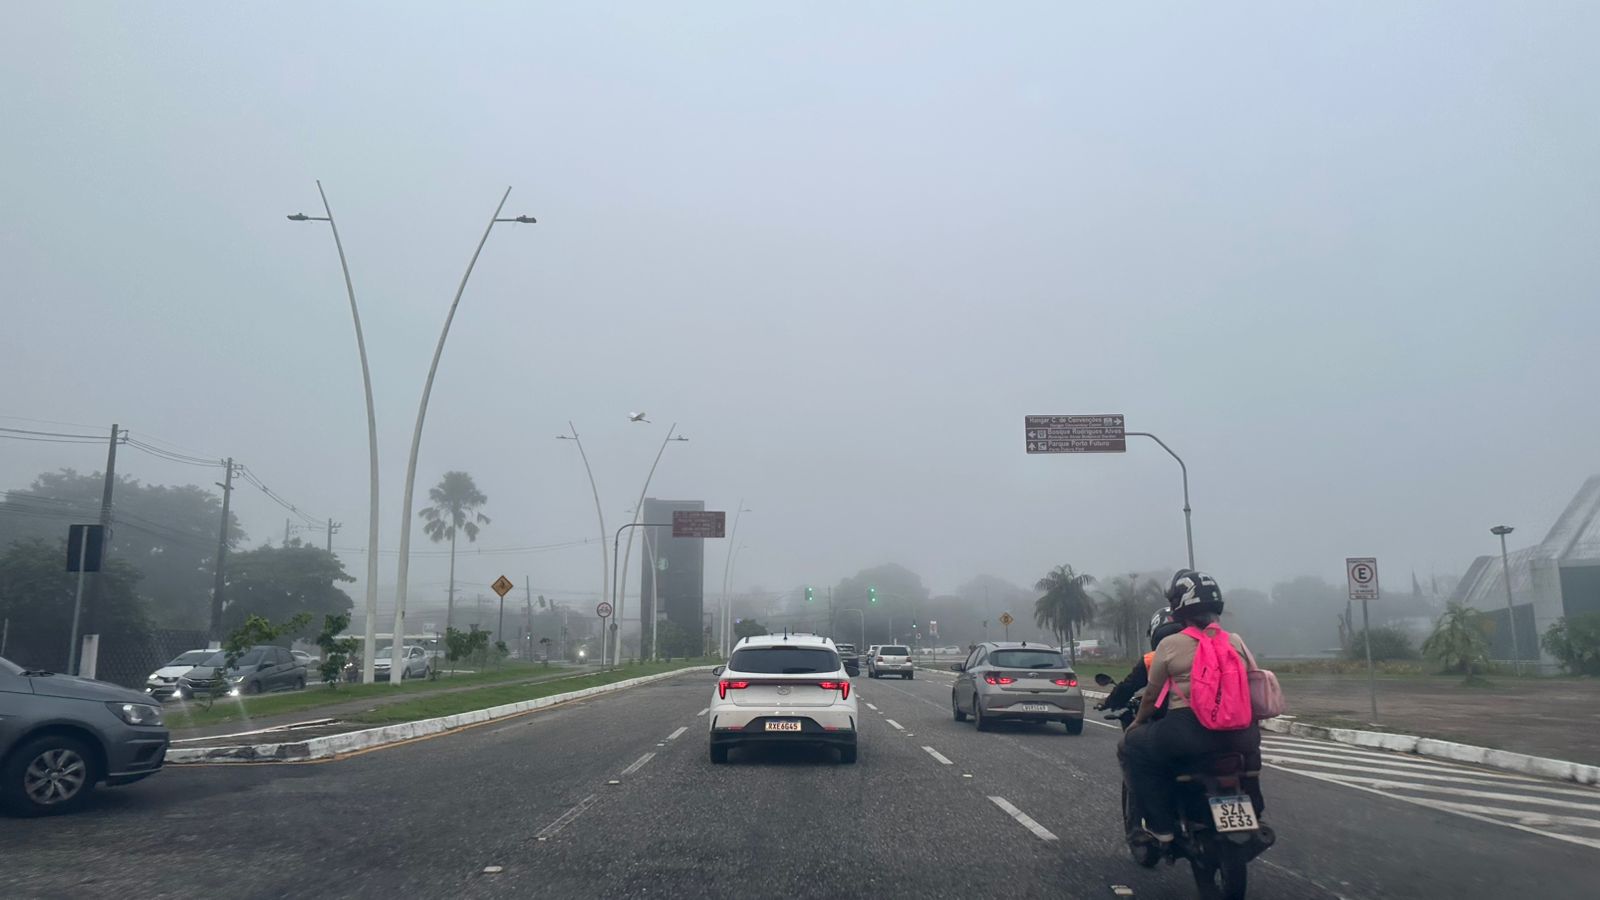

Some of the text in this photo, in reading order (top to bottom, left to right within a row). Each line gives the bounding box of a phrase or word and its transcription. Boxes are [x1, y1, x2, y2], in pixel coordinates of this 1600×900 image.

[1029, 417, 1049, 425] Hangar
[1048, 428, 1070, 436] Bosque
[1048, 440, 1069, 448] Parque
[1358, 567, 1367, 580] E
[1220, 803, 1246, 816] SZA
[1219, 814, 1253, 829] 5E33
